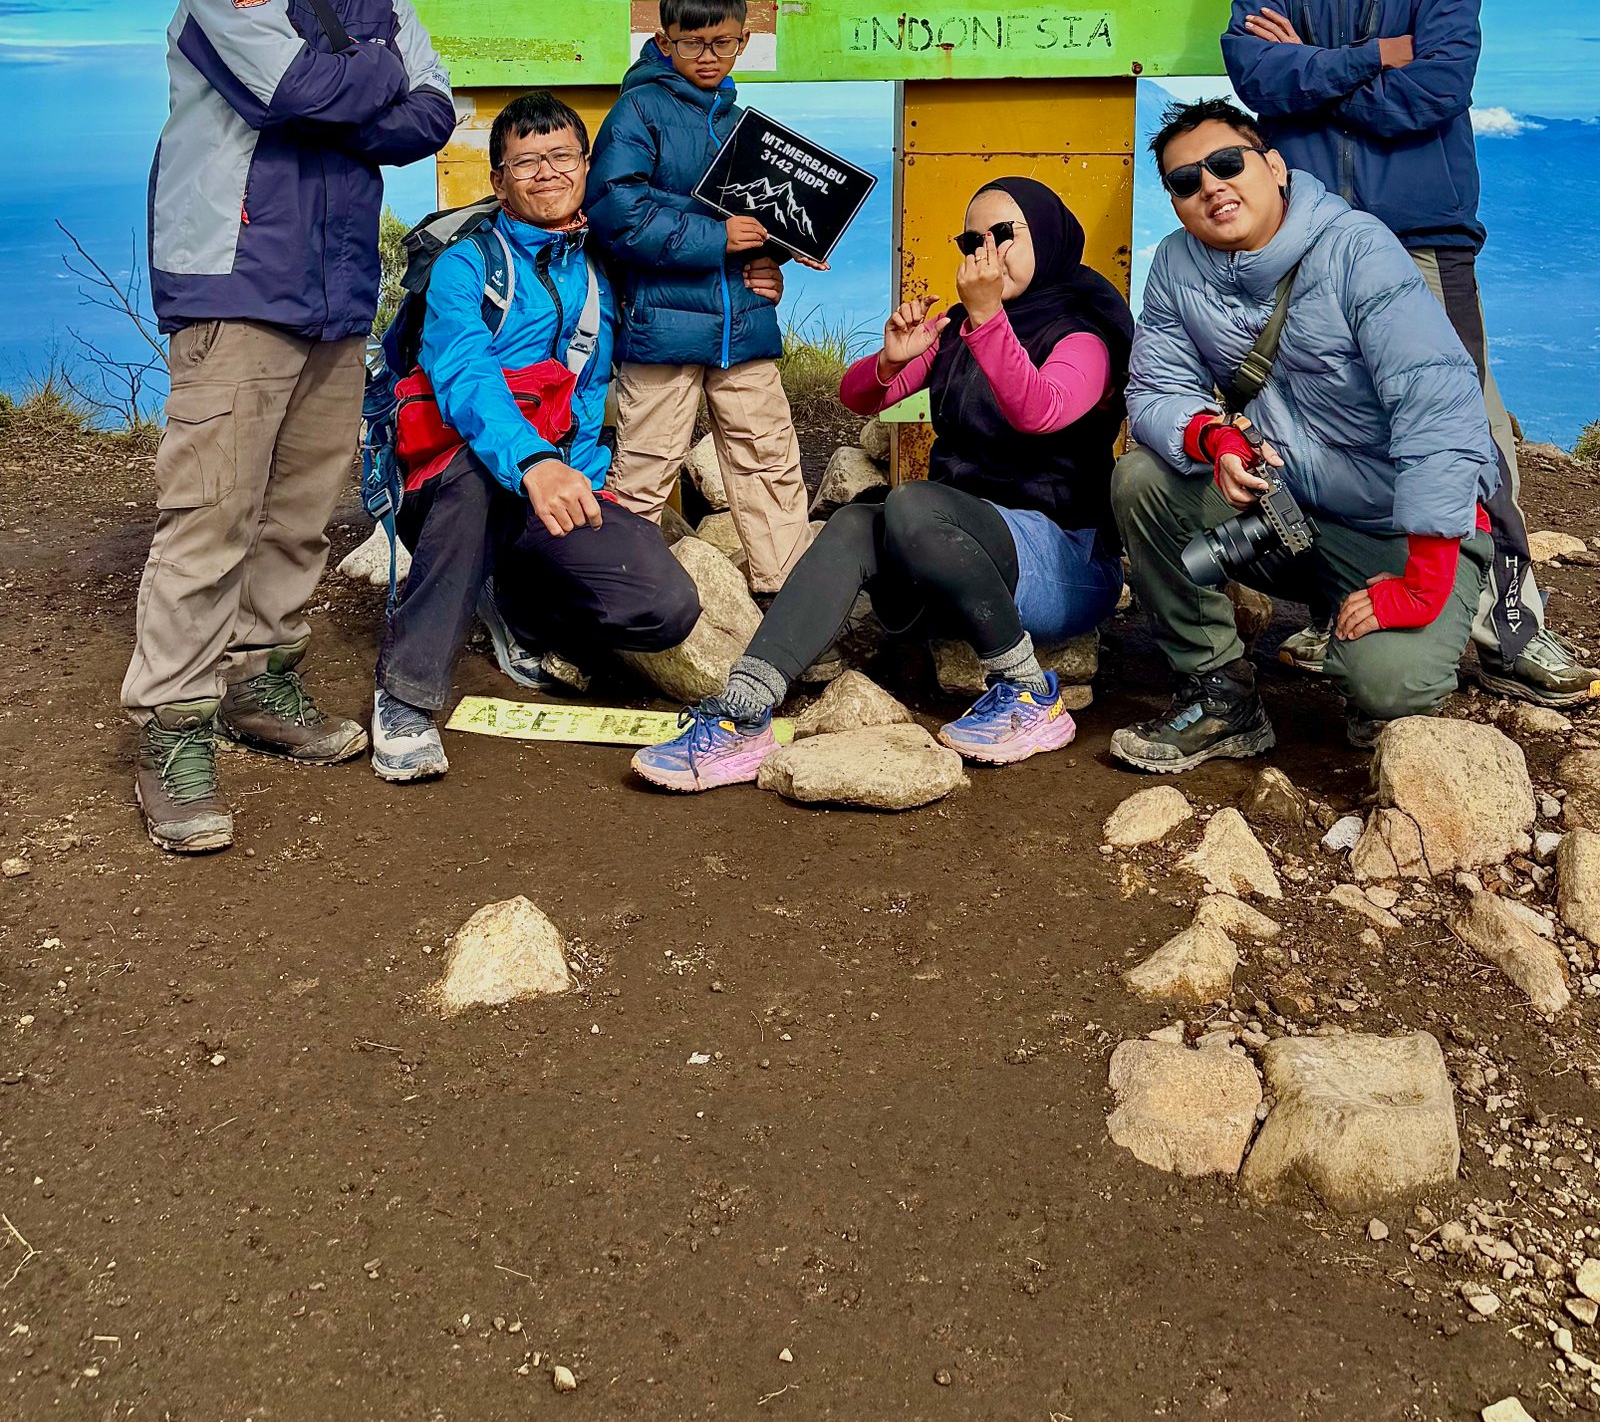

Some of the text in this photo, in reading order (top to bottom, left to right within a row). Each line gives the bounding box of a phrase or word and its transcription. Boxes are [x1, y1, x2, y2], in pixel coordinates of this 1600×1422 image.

[847, 15, 1113, 52] INDONESIA
[761, 131, 847, 185] MT.MERBABU
[761, 149, 829, 195] 3142 MDPL
[468, 704, 593, 734] ASET
